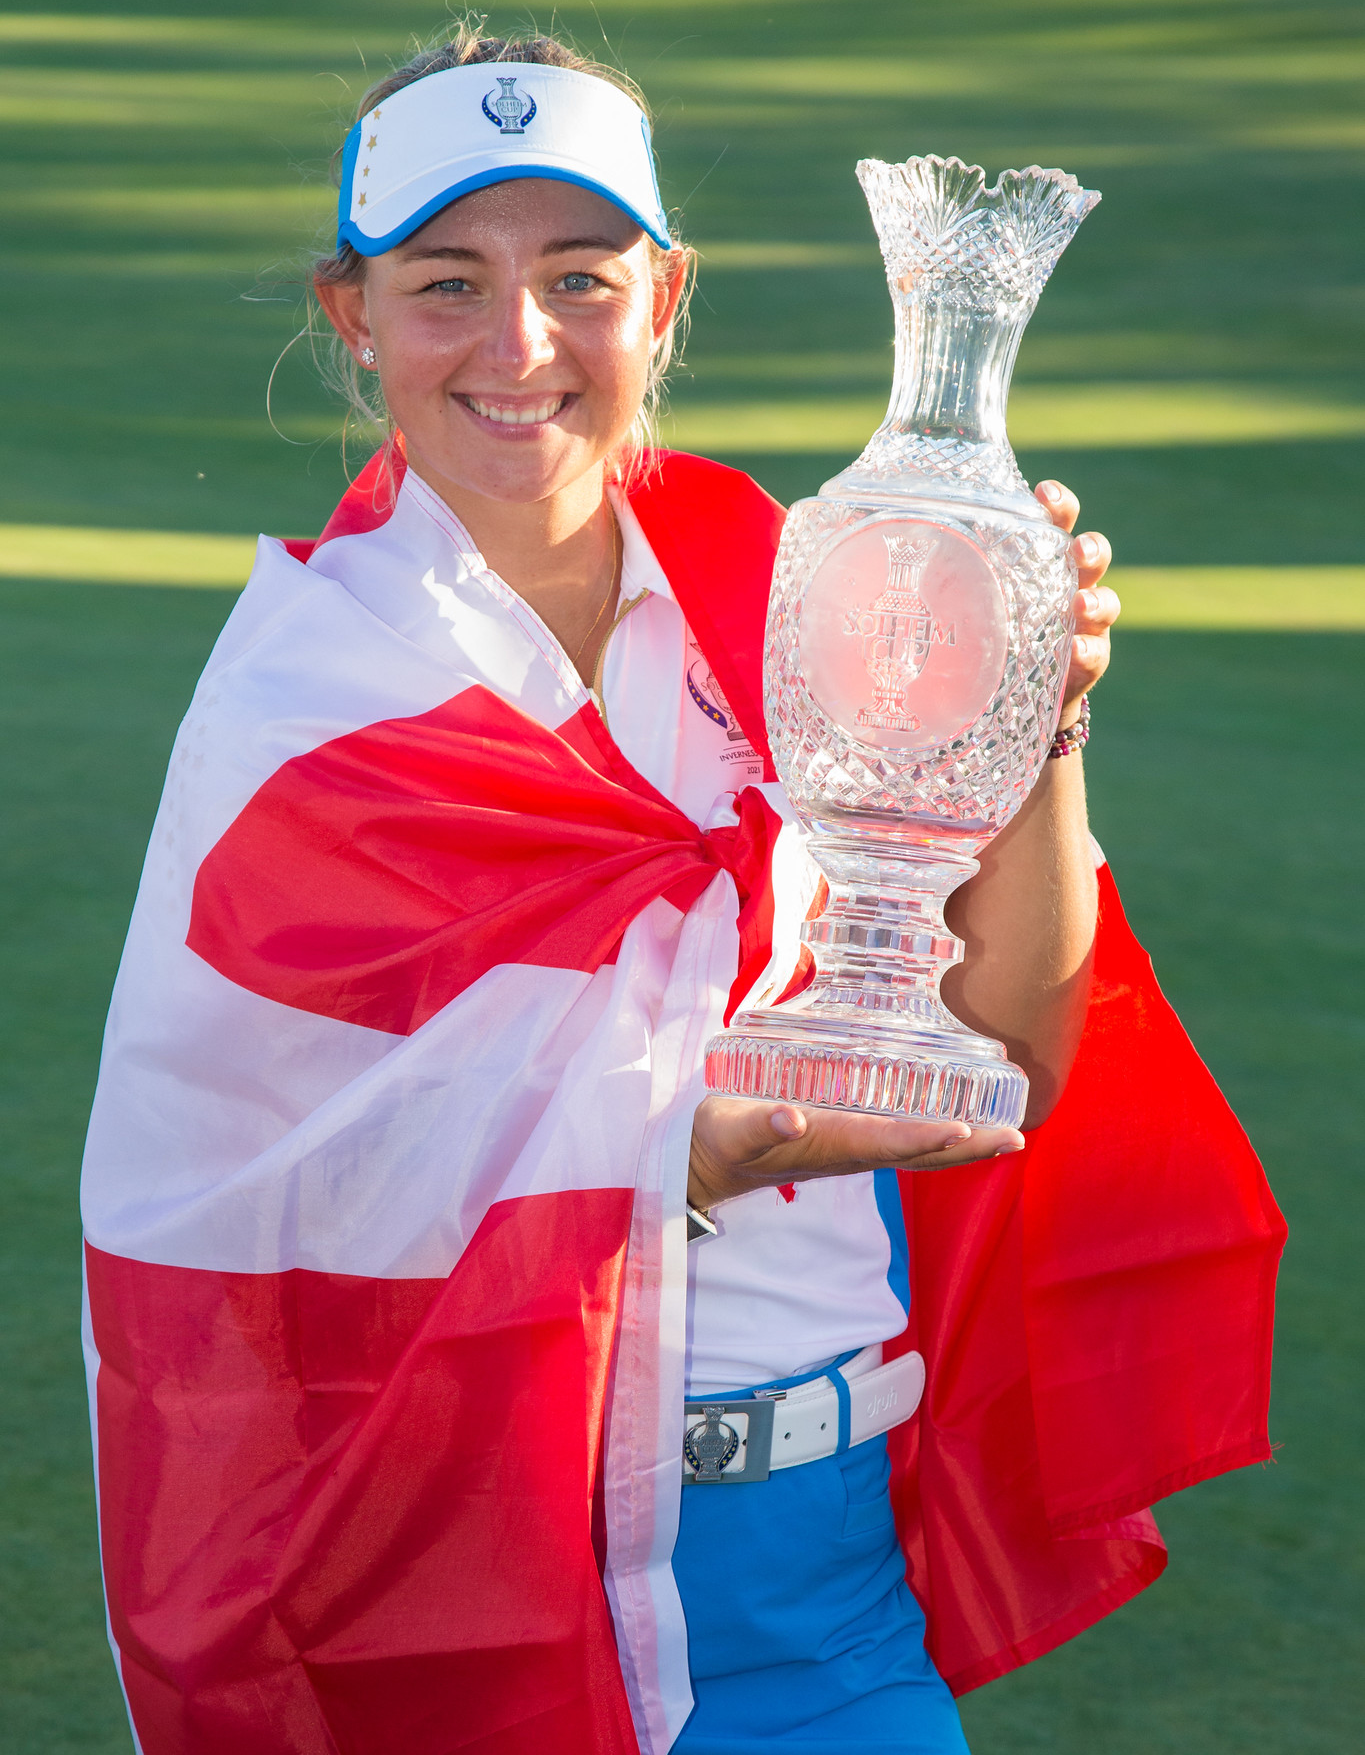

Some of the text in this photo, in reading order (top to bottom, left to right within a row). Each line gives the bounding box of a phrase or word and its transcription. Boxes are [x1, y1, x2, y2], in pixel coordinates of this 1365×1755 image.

[843, 609, 957, 646] SOLHEIM
[871, 638, 925, 664] CUP
[747, 766, 761, 774] 2021
